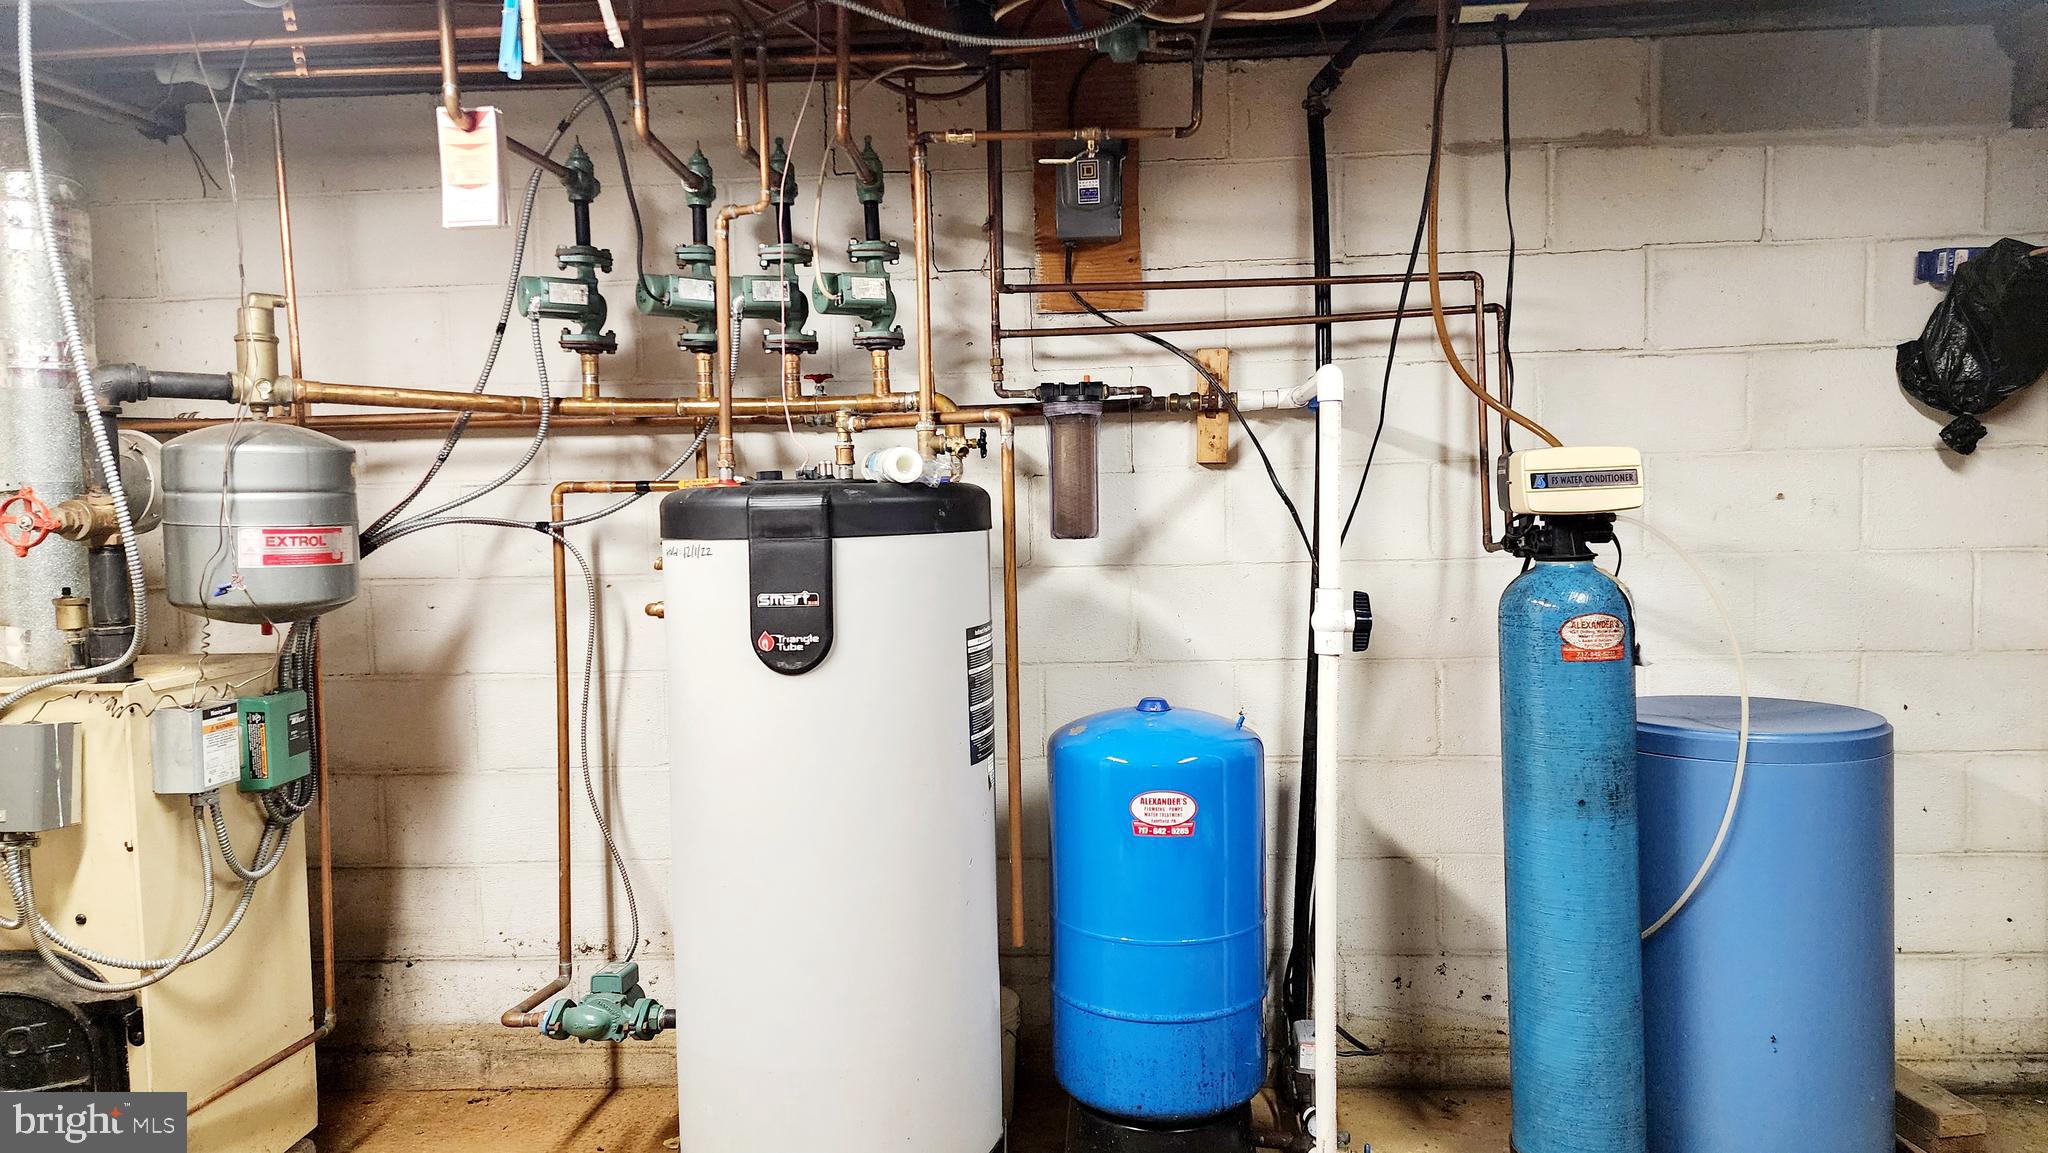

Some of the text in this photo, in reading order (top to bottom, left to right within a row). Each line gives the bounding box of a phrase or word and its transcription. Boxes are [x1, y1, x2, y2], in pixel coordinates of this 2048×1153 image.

[1551, 473, 1634, 485] FS WATER CONDITIONER
[265, 535, 327, 547] EXTROL
[758, 591, 810, 606] smart
[1571, 620, 1620, 629] ALEXANDER'S
[776, 634, 820, 645] Triangle
[776, 643, 804, 651] Tube
[1140, 797, 1188, 806] ALEXANDER'S
